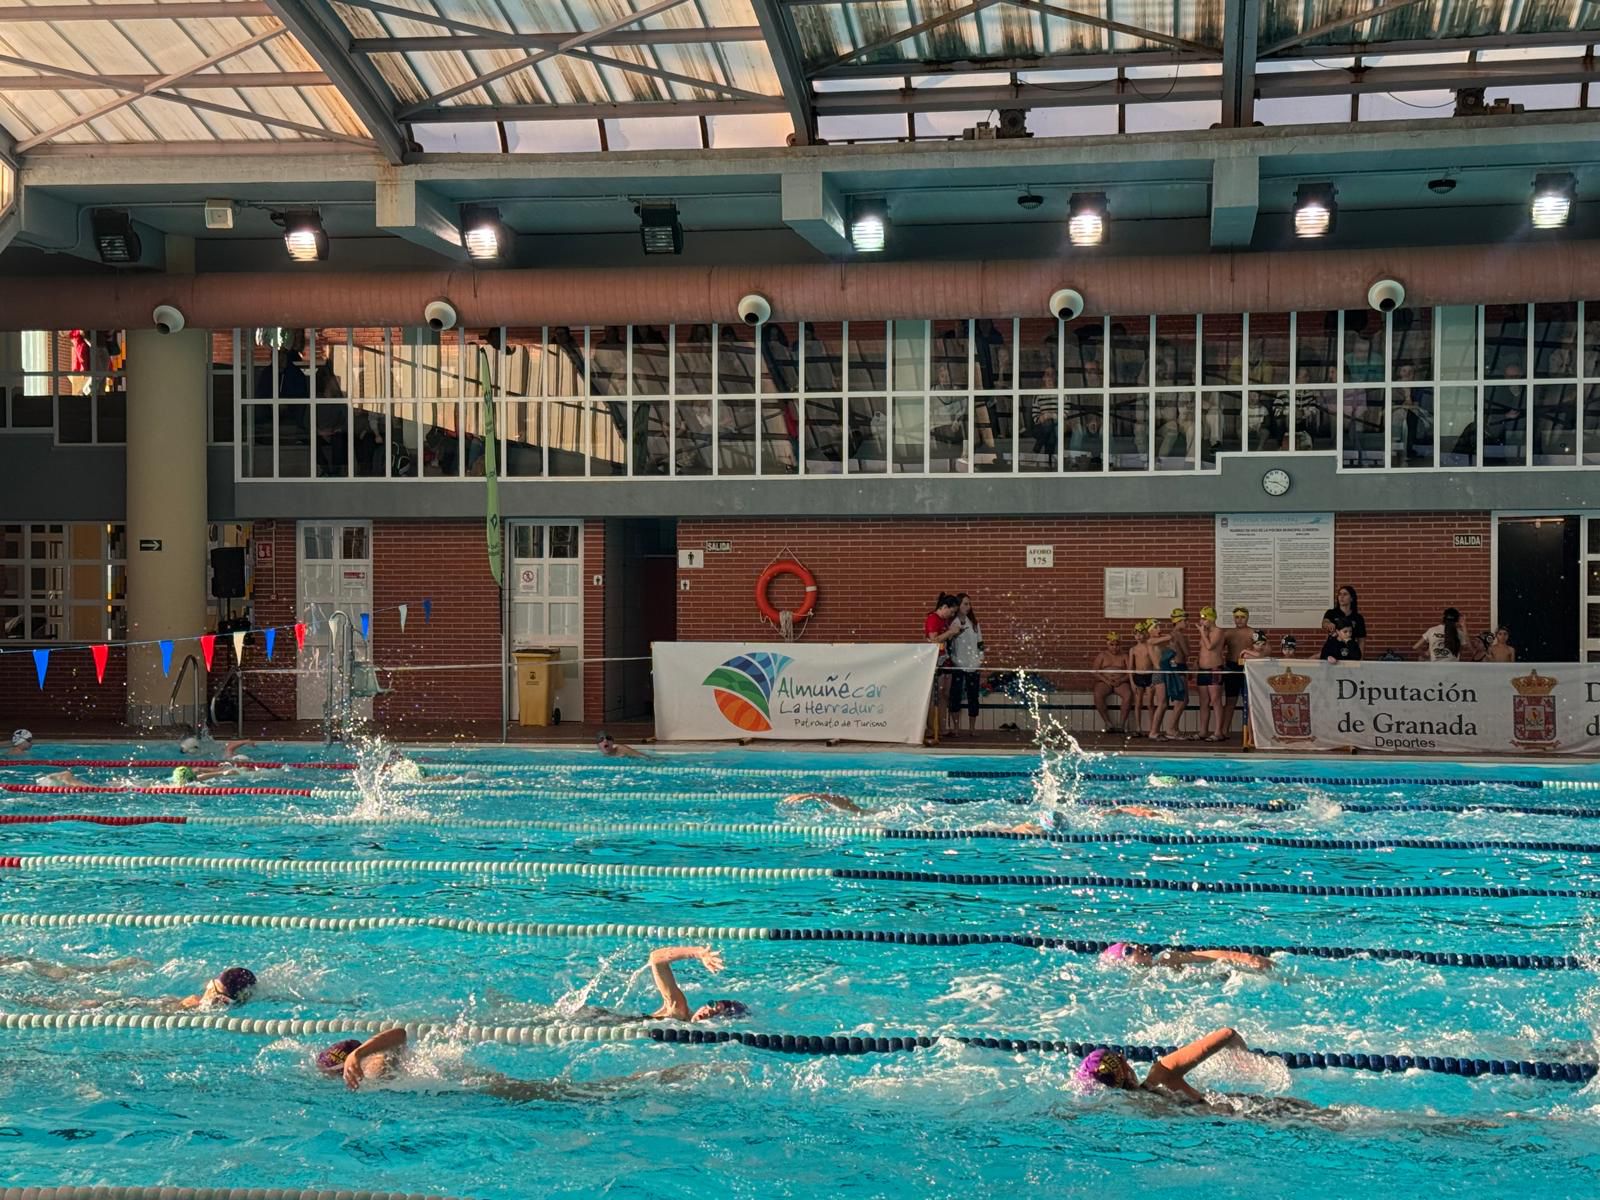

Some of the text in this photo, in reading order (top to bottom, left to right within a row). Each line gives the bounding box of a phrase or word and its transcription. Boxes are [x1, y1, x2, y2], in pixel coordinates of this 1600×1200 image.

[1455, 535, 1481, 545] SALIDA
[1033, 557, 1047, 565] 175
[777, 672, 887, 699] Almuñécar
[1336, 679, 1478, 705] Diputación
[779, 701, 885, 715] La Herradura
[794, 719, 887, 728] Patronato de Turismo
[1337, 712, 1478, 736] de Granada
[1375, 736, 1436, 749] Deportes
